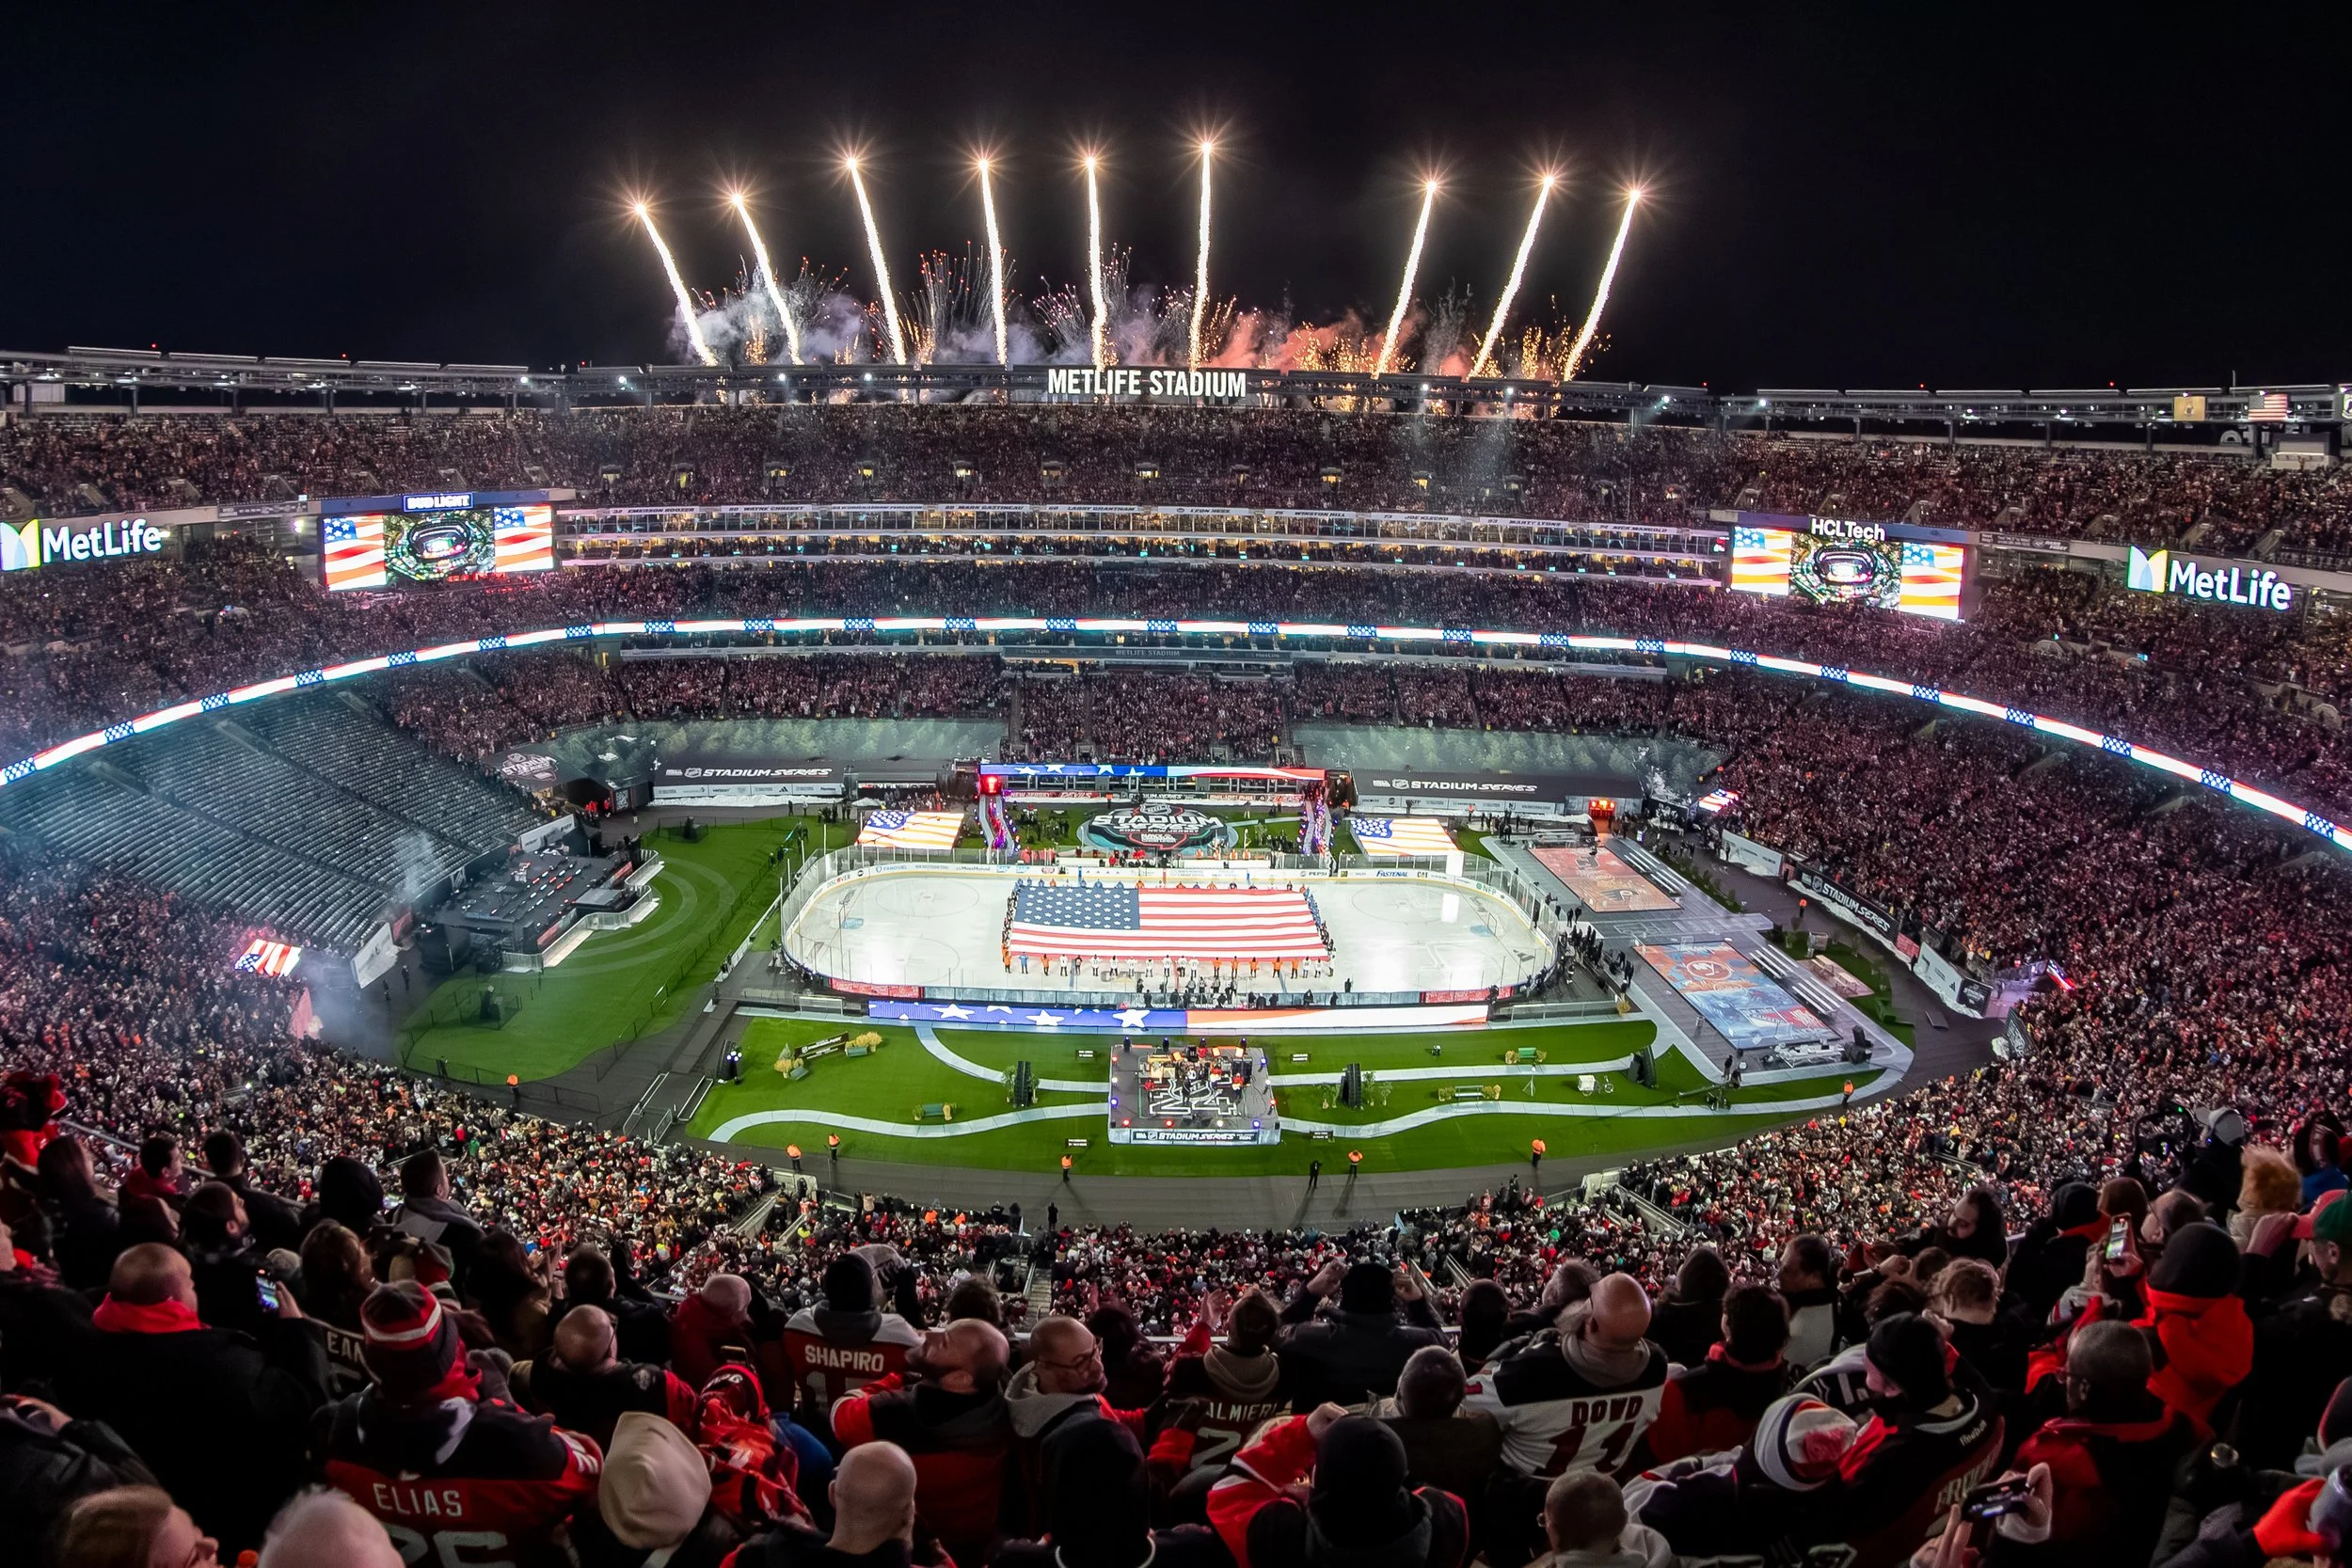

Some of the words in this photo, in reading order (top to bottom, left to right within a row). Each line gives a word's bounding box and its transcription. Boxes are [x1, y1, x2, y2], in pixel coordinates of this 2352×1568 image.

[1048, 368, 1142, 395] METLIFE
[1149, 370, 1247, 398] STADIUM
[406, 497, 434, 510] BUD
[434, 495, 470, 508] LIGHT
[42, 518, 163, 563] MetLife
[1810, 517, 1886, 541] HCLTech
[2169, 559, 2293, 610] MetLife
[702, 768, 771, 777] STADIUM
[771, 768, 833, 776] SERIES
[1410, 780, 1478, 790] STADIUM
[1477, 784, 1538, 793] SERIES
[1091, 815, 1224, 828] STADIUM
[1375, 869, 1408, 878] FASTENAL
[1821, 882, 1860, 913] STADIUM
[1857, 905, 1891, 932] SERIES
[1158, 1132, 1200, 1140] STADIUM
[1200, 1132, 1236, 1140] SERIES
[804, 1343, 884, 1373] SHAPIRO
[1569, 1395, 1645, 1427] DOWD
[373, 1482, 463, 1518] ELIAS
